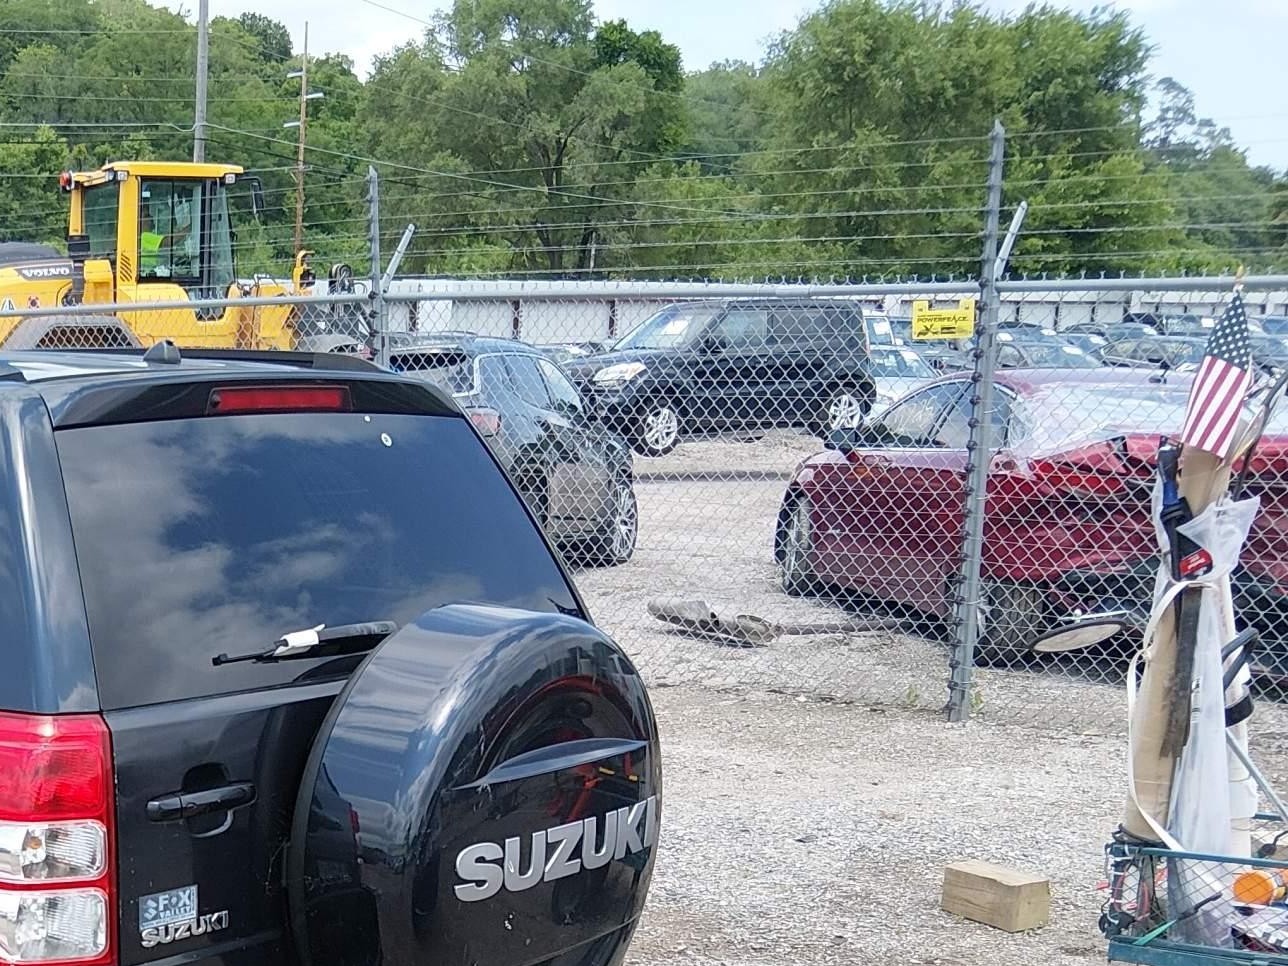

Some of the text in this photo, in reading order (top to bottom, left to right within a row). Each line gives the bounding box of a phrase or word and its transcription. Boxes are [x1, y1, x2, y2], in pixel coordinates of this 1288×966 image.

[22, 266, 70, 277] VOLVO
[454, 795, 655, 902] SUZUKI
[158, 889, 191, 911] FOX
[159, 905, 191, 919] VALLEY
[141, 910, 229, 948] SUZUKI
